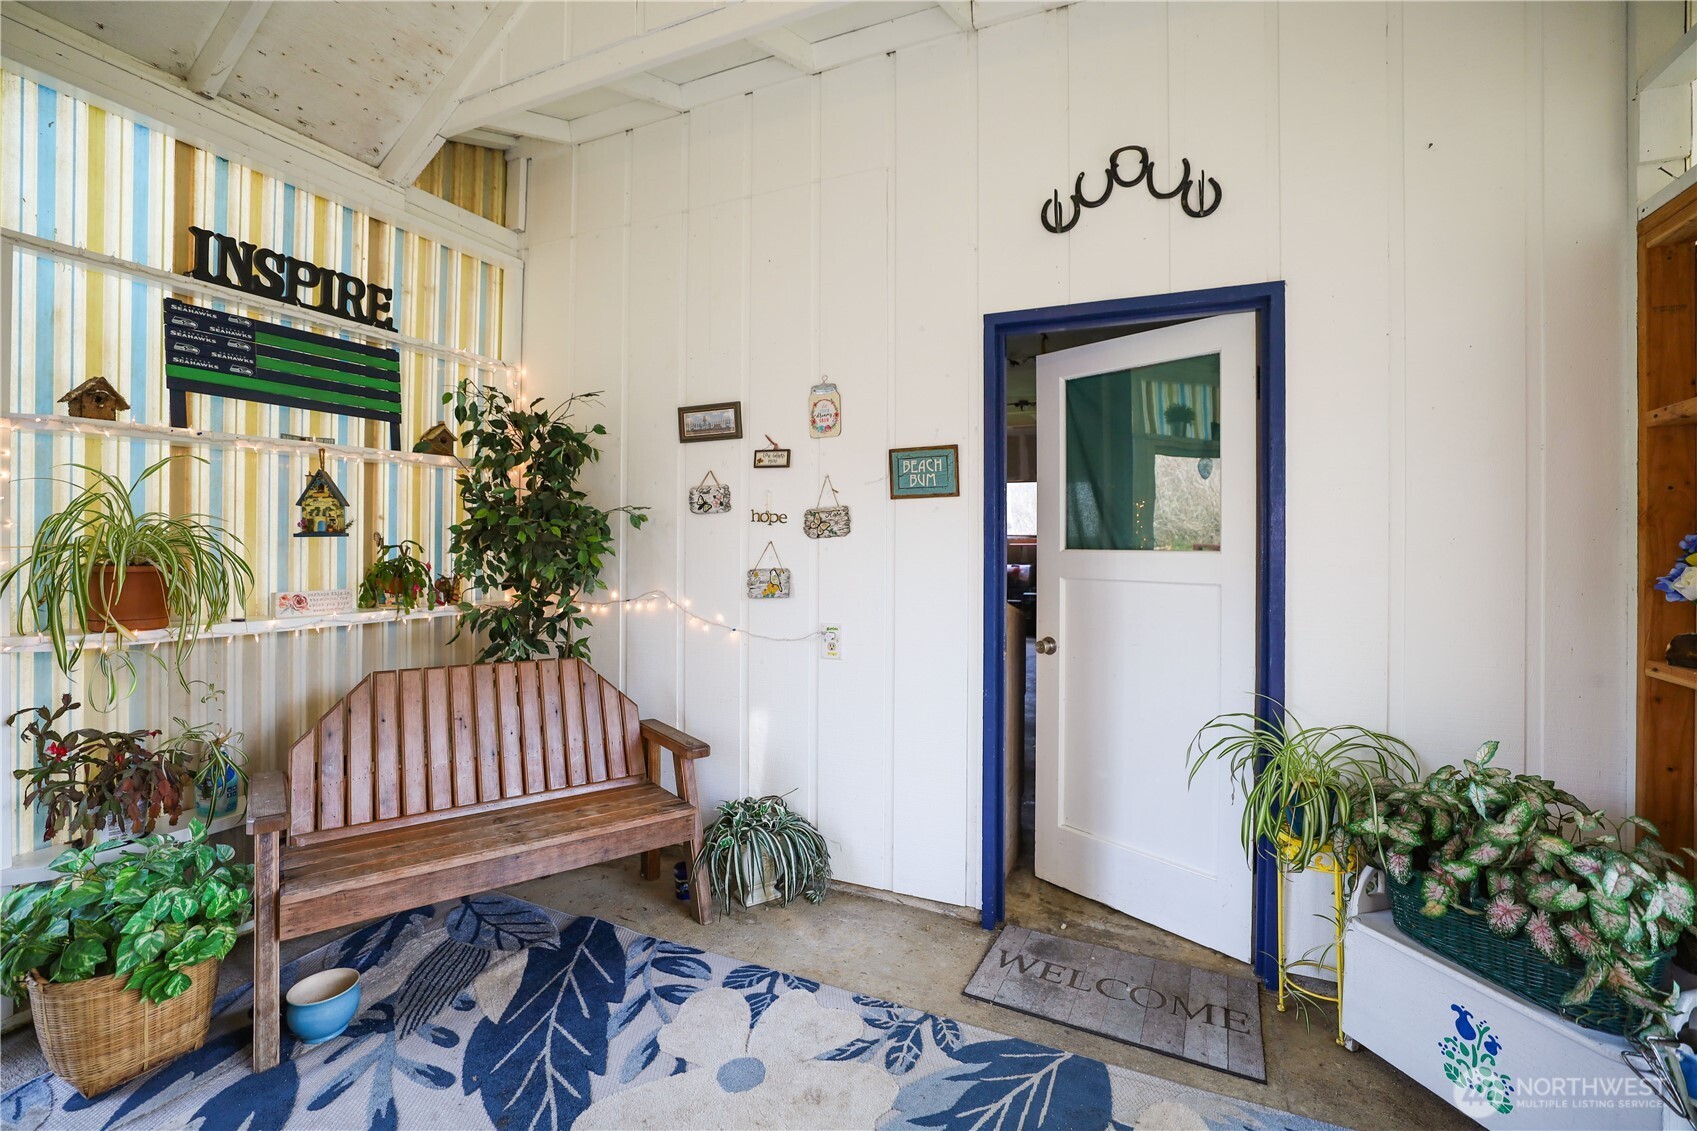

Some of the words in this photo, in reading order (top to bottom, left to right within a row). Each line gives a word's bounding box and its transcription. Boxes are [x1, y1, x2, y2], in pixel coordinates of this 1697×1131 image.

[188, 226, 398, 333] INSPIRE
[170, 304, 218, 319] SEAHAWKS
[169, 330, 217, 344] SEAHAWKS
[209, 326, 253, 339] SEAHAWKS
[172, 357, 219, 370] SEAHAWKS
[211, 352, 254, 364] SEAHAWKS
[902, 458, 943, 473] BEACH
[909, 473, 937, 488] BUM
[750, 509, 788, 526] hope
[999, 949, 1251, 1035] WELCOME
